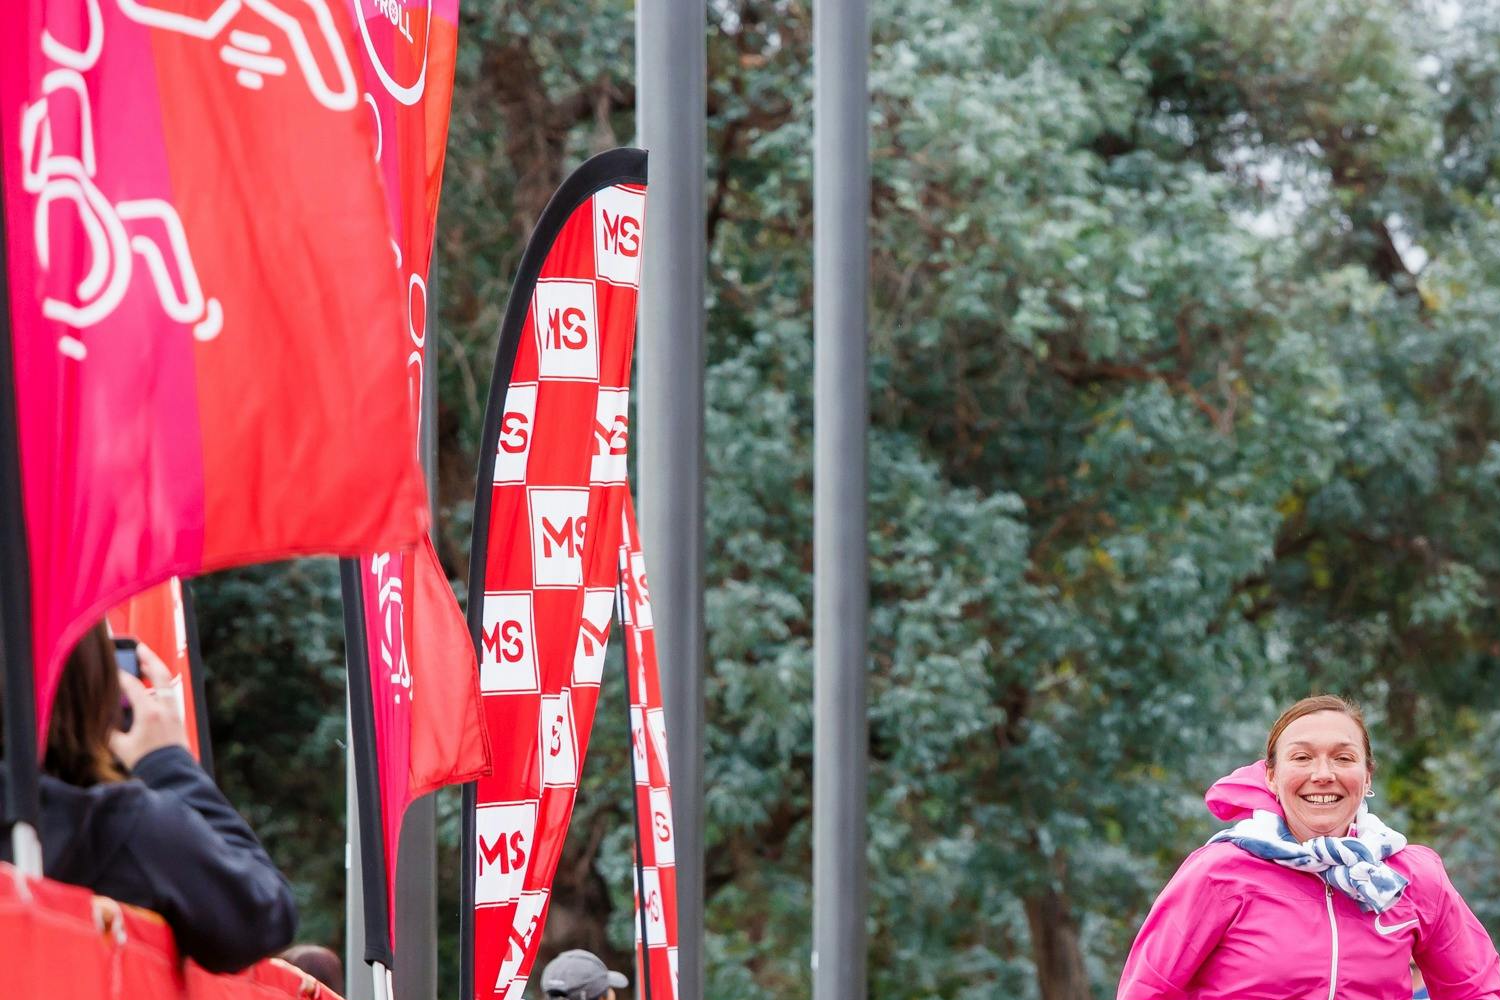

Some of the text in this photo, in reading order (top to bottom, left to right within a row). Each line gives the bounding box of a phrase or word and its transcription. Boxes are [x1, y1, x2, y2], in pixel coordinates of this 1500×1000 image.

[602, 208, 640, 258] MS
[545, 307, 589, 350] MS
[496, 411, 528, 456] S
[481, 620, 524, 664] MS
[478, 831, 526, 878] MS
